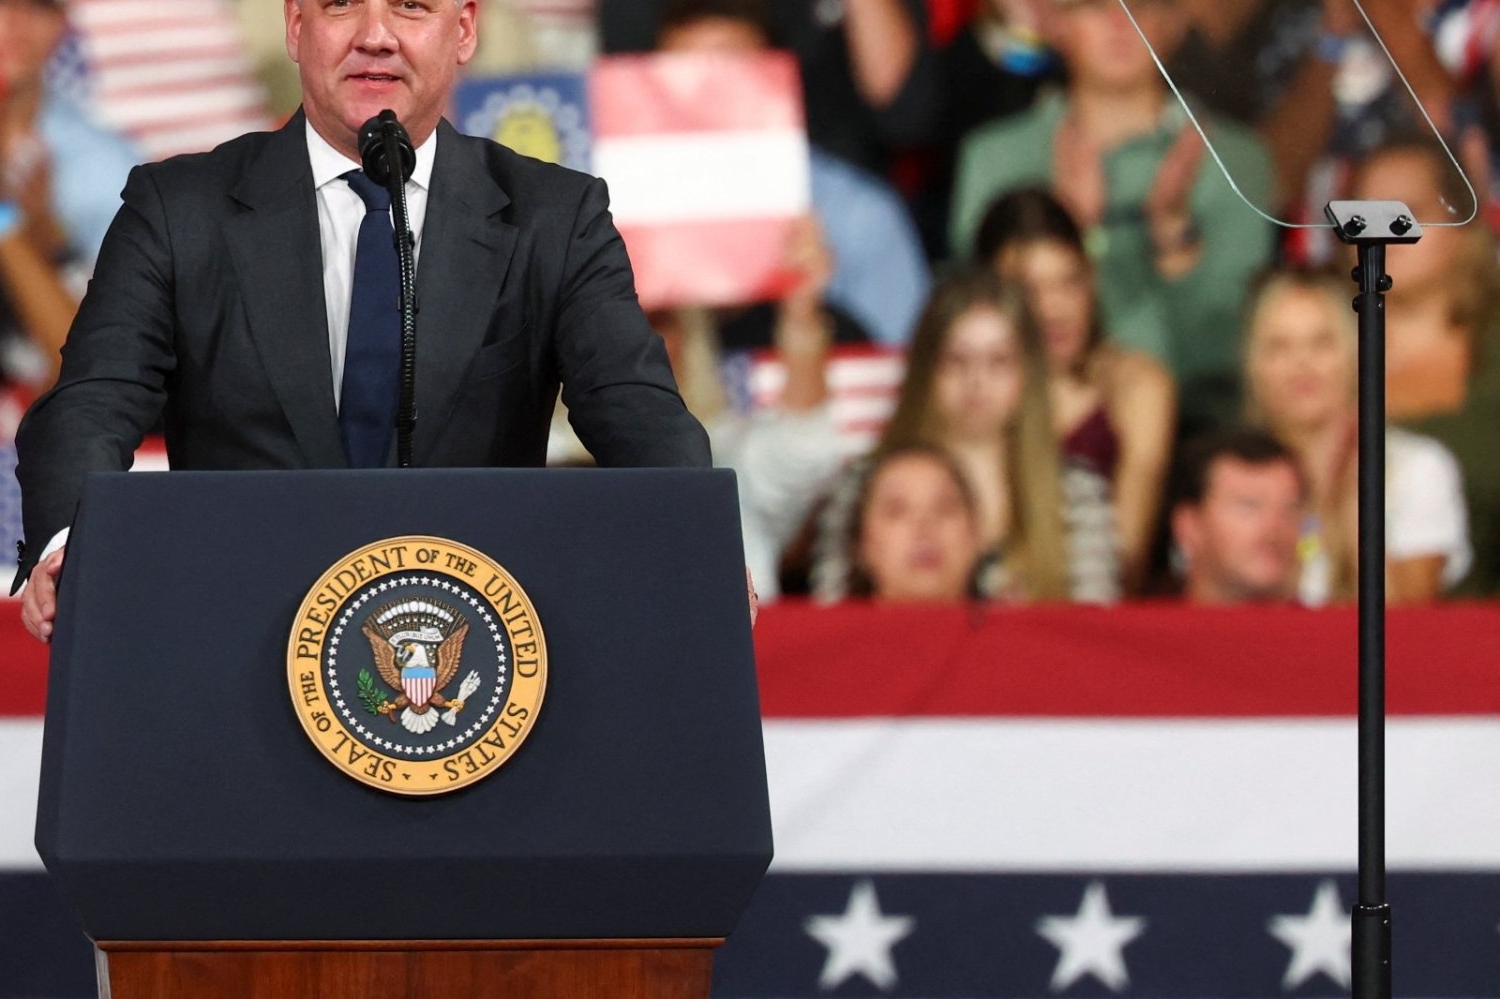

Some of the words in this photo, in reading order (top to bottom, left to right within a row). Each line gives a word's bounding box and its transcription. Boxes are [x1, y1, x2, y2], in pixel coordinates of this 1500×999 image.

[416, 548, 440, 563] OF
[445, 553, 477, 578] THE
[297, 546, 407, 661] PRESIDENT
[484, 574, 538, 678] UNITED
[300, 671, 319, 706] THE
[311, 710, 331, 732] OF
[443, 702, 529, 781] STATES
[332, 729, 397, 782] SEAL
